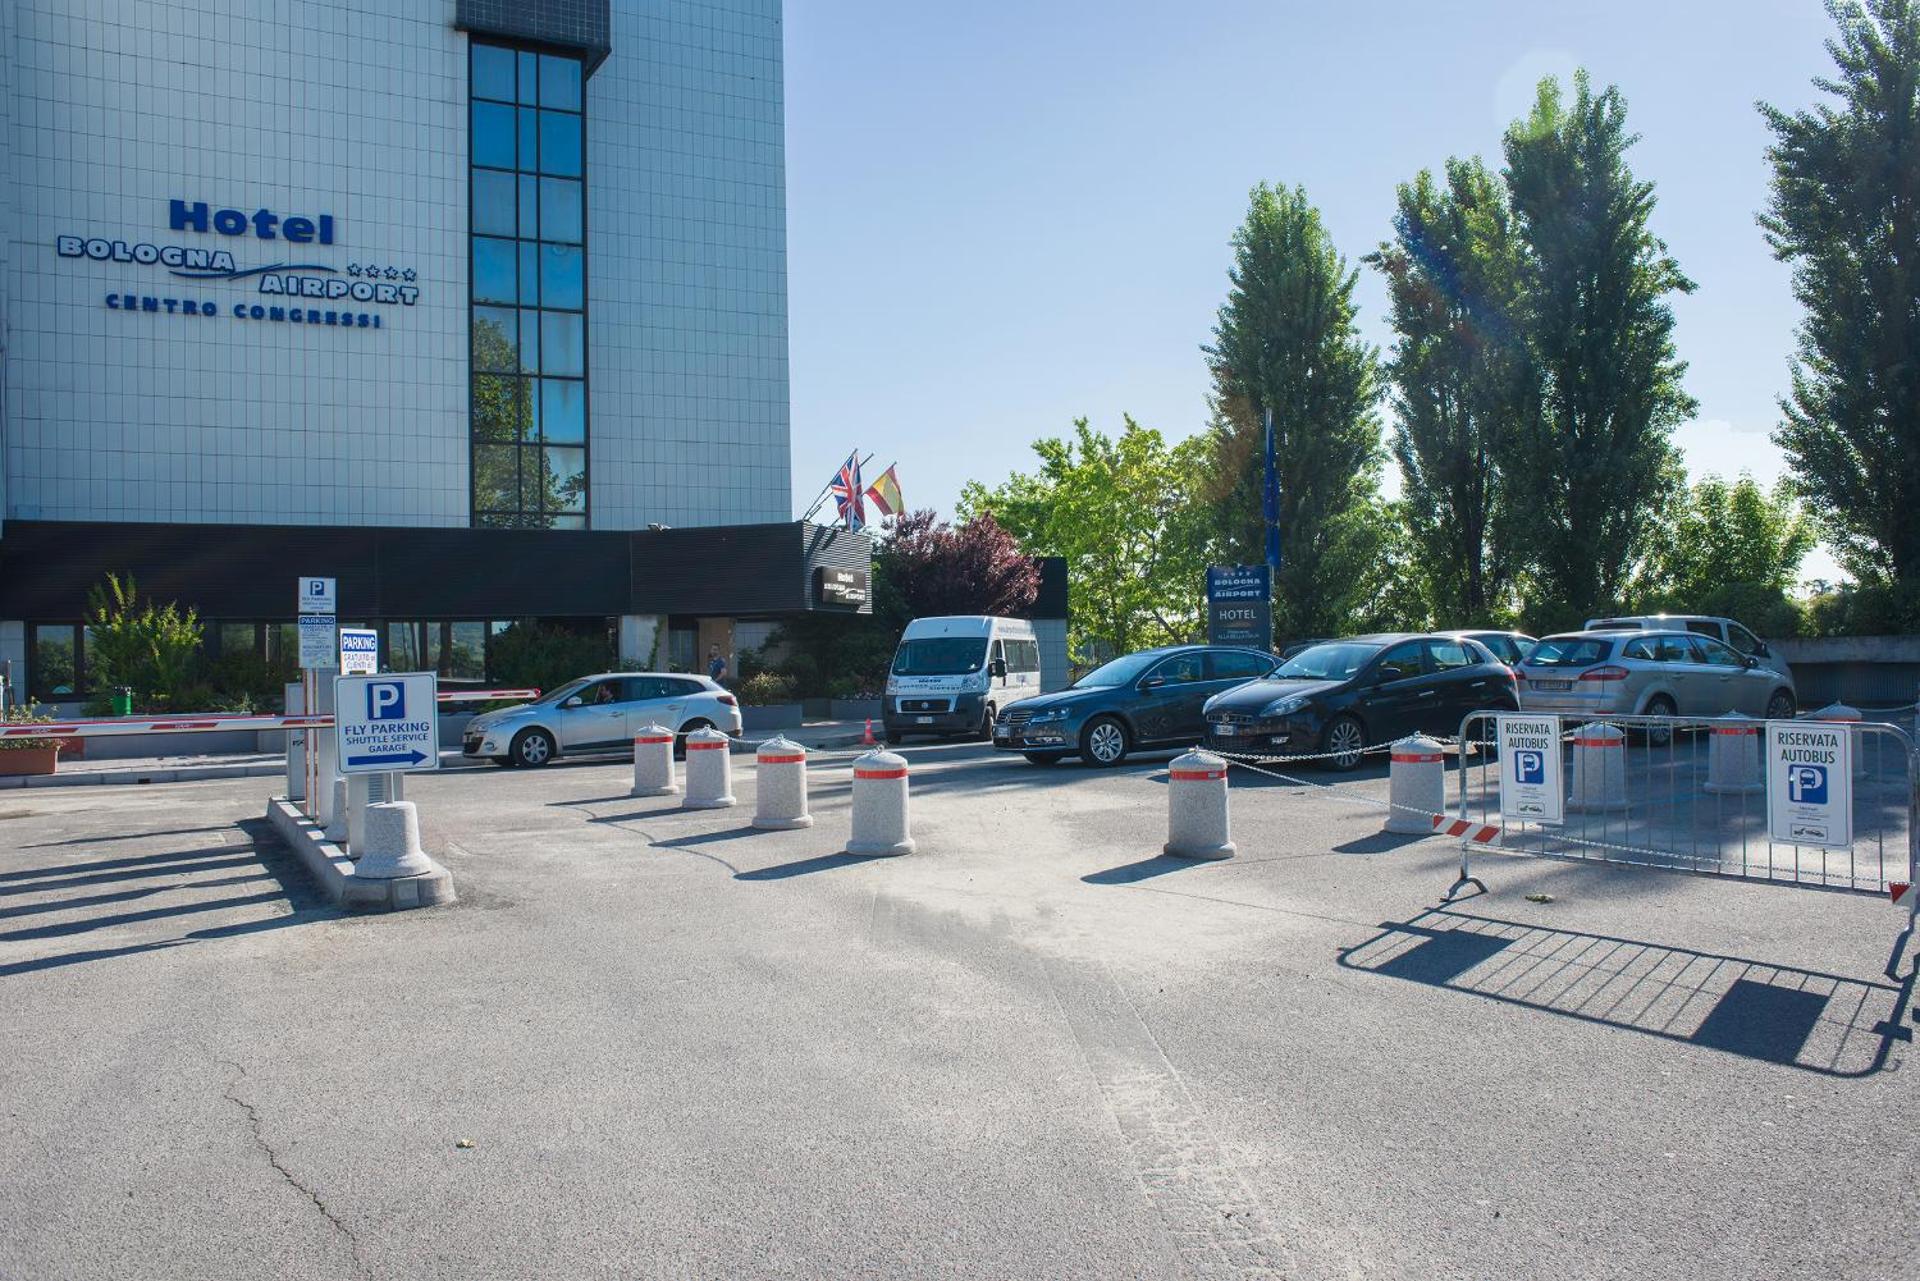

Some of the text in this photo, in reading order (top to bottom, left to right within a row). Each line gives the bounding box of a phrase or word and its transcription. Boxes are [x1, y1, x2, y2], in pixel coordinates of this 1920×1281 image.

[169, 199, 334, 246] Hotel
[57, 235, 235, 273] BOLOGNA
[259, 274, 420, 306] AIRPORT
[105, 293, 381, 329] CENTRO CONGRESSI
[1214, 578, 1261, 586] BOLOGNA
[1214, 590, 1261, 598] AIRPORT
[300, 617, 335, 625] PARKING
[1219, 609, 1257, 620] HOTEL
[343, 636, 375, 650] PARKING
[372, 684, 398, 719] P
[345, 721, 430, 735] FLY PARKING
[1505, 722, 1551, 735] RISERVATA
[346, 732, 429, 745] SHUTTLE SERVICE
[1508, 737, 1549, 749] AUTOBUS
[1778, 732, 1838, 748] RISERVATA
[368, 744, 407, 753] GARAGE
[1781, 749, 1835, 764] AUTOBUS
